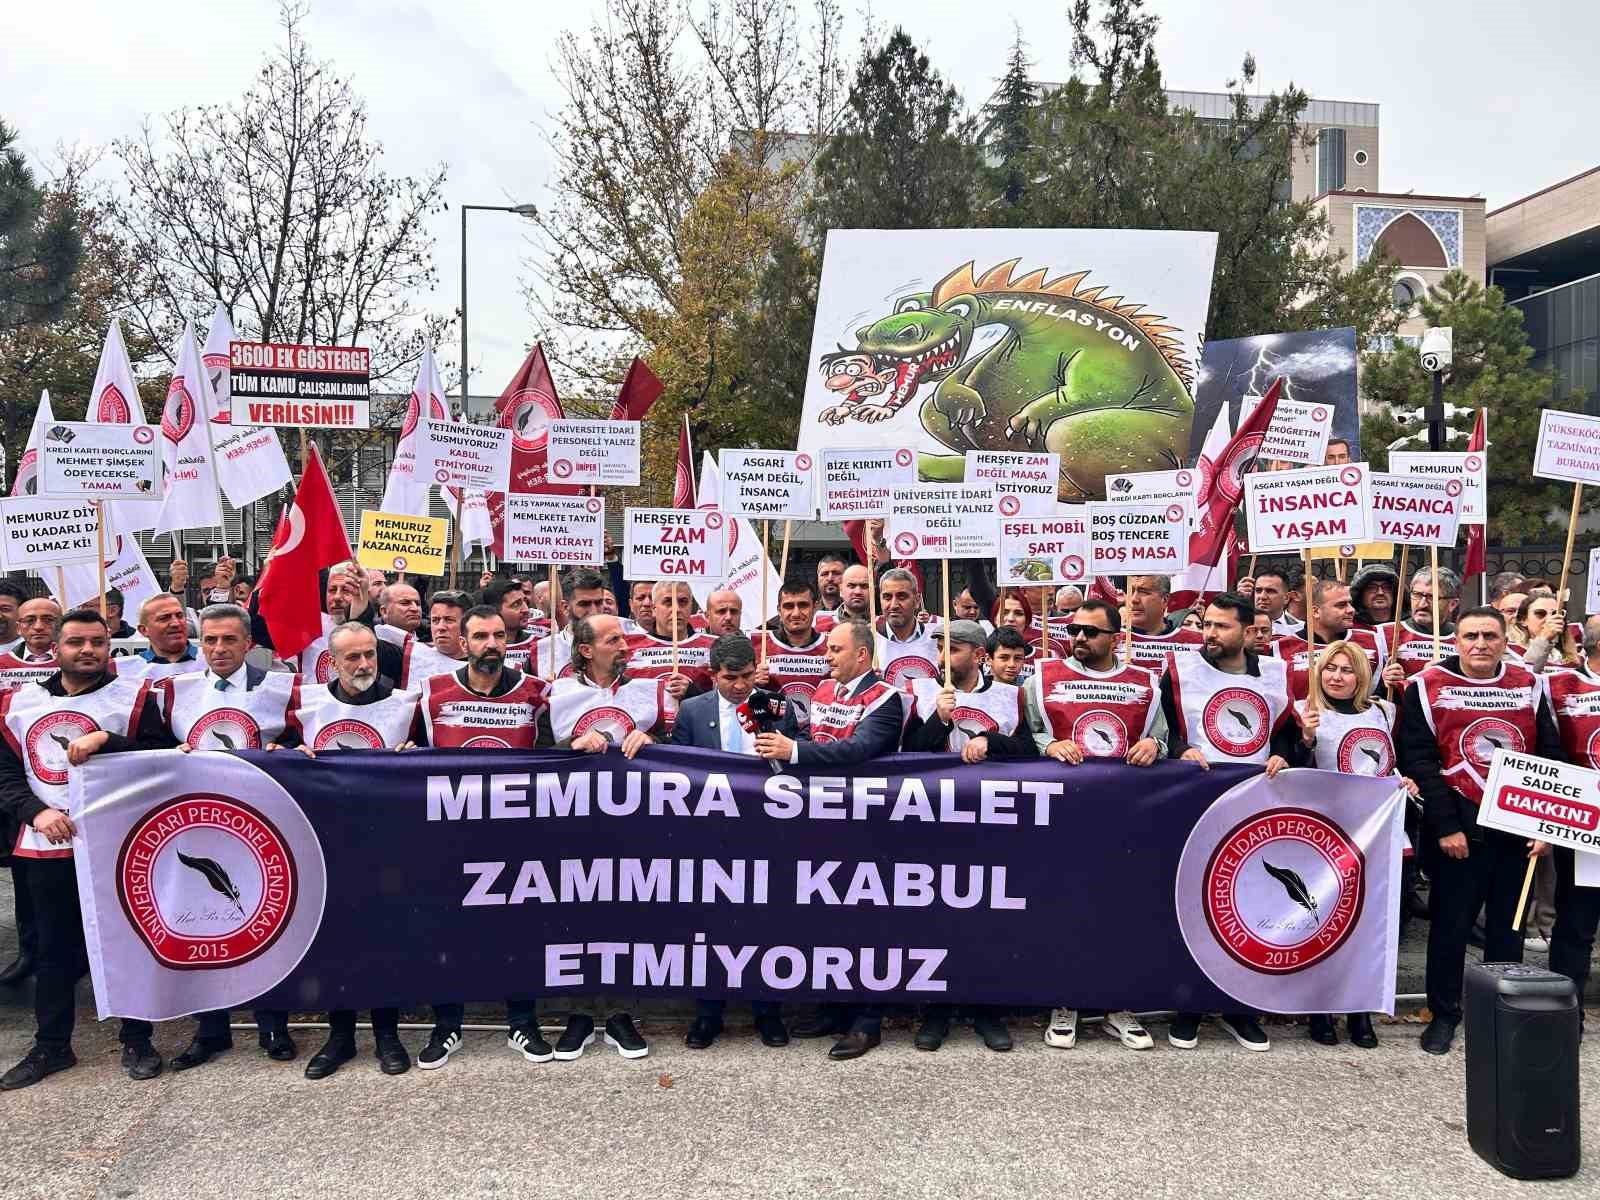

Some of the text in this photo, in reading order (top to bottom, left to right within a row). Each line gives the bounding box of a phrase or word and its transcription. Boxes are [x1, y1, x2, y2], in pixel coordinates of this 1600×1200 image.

[993, 299, 1140, 352] ENFLASYON
[231, 343, 272, 368] 3600
[277, 348, 294, 369] EK
[297, 345, 368, 371] GÖSTERGE
[231, 372, 369, 397] TÜM KAMU ÇALIŞANLARINA
[893, 362, 920, 410] MEMUR
[248, 401, 354, 425] VERİLSİN!!!
[608, 424, 634, 434] İDARİ
[430, 434, 498, 450] SUSMUYORUZ!
[604, 438, 636, 446] YALNIZ
[46, 446, 72, 454] KREDİ
[449, 449, 480, 460] KABUL
[580, 448, 608, 457] DEĞİL!
[1260, 446, 1309, 459] KKIMIZDIR
[56, 458, 144, 467] MEHMET ŞİMŞEK
[743, 456, 785, 468] ASGARİ
[827, 458, 892, 470] BİZE KIRINTI
[976, 454, 1048, 466] HERŞEYE ZAM
[976, 467, 1008, 478] DEĞİL
[1410, 465, 1463, 474] MEMURUN
[726, 470, 804, 485] YAŞAM DEĞİL,
[828, 472, 860, 482] DEĞİL,
[81, 482, 122, 490] TAMAM
[995, 483, 1052, 494] İSTİYORUZ
[1254, 482, 1284, 490] ASGARİ
[1286, 480, 1313, 488] YAŞAM
[1372, 480, 1398, 488] ASGARİ
[1400, 482, 1424, 490] YAŞAM
[740, 488, 790, 498] İNSANCA
[828, 488, 890, 500] EMEĞİMİZİN
[960, 488, 992, 498] İDARİ
[829, 500, 884, 511] KARŞILIĞI!
[1258, 490, 1358, 514] İNSANCA
[1372, 492, 1454, 514] İNSANCA
[6, 506, 97, 525] MEMURUZ DİY
[956, 504, 994, 514] YALNIZ
[514, 513, 566, 522] MEMLEKETE
[634, 513, 691, 526] HERŞEYE
[926, 517, 961, 528] DEĞİL!
[1092, 512, 1166, 526] BOŞ CÜZDAN
[12, 529, 28, 539] BU
[32, 525, 82, 537] KADARI
[375, 519, 432, 533] MEMURUZ
[540, 526, 568, 534] HAYAL
[1004, 520, 1085, 537] EŞEL MOBİL
[1272, 518, 1347, 540] YAŞAM
[1380, 521, 1441, 540] YAŞAM
[375, 530, 430, 544] HAKLIYIZ
[512, 536, 594, 546] MEMUR KİRAYI
[660, 527, 706, 544] ZAM
[1092, 530, 1169, 542] BOŞ TENCERE
[26, 536, 92, 553] OLMAZ Kİ!
[362, 540, 442, 556] KAZANACAĞIZ
[633, 544, 690, 556] MEMURA
[1028, 542, 1064, 556] ŞART
[516, 550, 548, 559] NASIL
[1094, 546, 1176, 562] BOŞ MASA
[660, 559, 706, 575] GAM
[1451, 688, 1504, 698] HAKLARIMIZ
[452, 704, 527, 716] HAKLARIMIZ İÇİN
[464, 716, 516, 726] BURADAYIZ!
[1503, 757, 1560, 778] MEMUR
[1522, 776, 1582, 798] SADECE
[425, 771, 1064, 827] MEMURA SEFALET
[1505, 792, 1592, 825] HAKKINI
[128, 806, 285, 947] ÜNİVERSİTE İDARİ PERSONEL SENDİKASI
[462, 857, 1027, 911] ZAMMINI KABUL
[1215, 820, 1356, 948] ÜNİVERSİTE İDARİ PERSONEL SENDİKASI
[188, 943, 229, 960] 2015
[544, 931, 949, 993] ETMİYORUZ
[1265, 951, 1299, 966] 2015
